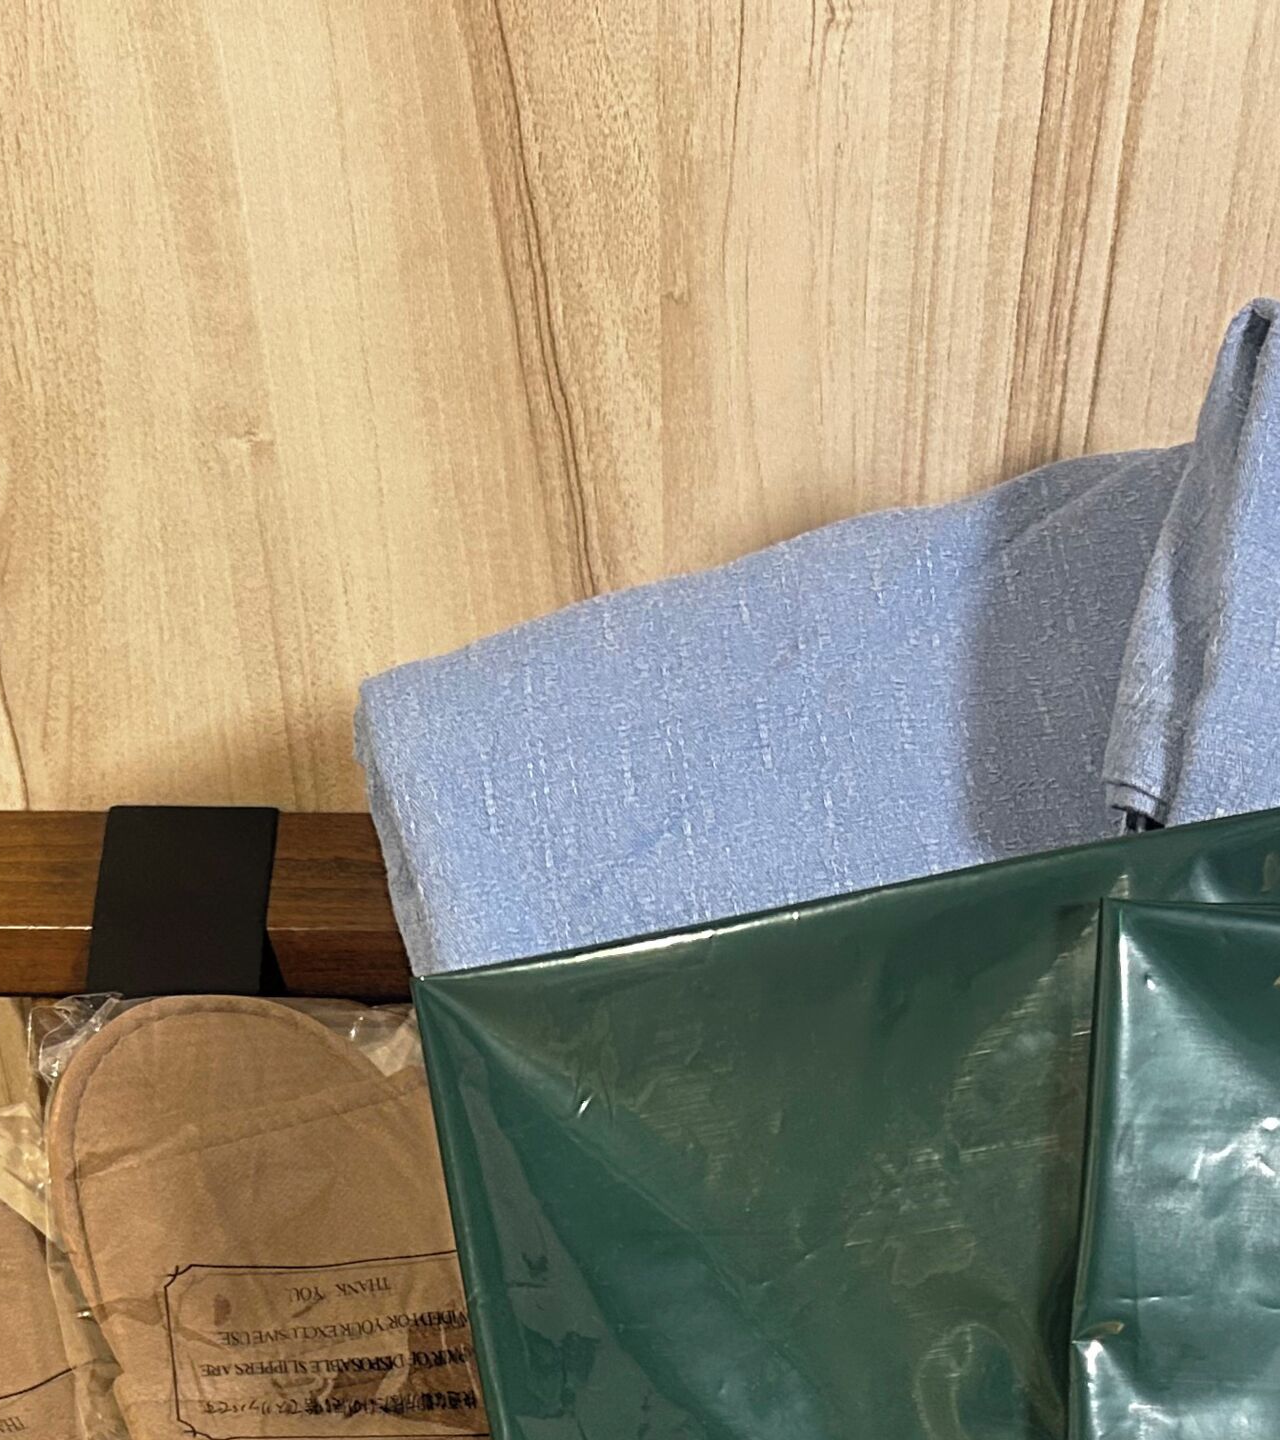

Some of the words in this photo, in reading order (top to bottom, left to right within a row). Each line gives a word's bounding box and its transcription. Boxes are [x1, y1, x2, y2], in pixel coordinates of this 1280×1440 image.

[335, 1276, 391, 1296] THANK
[292, 1287, 324, 1302] YOU
[253, 1325, 336, 1344] EXCLUSIVE
[340, 1317, 384, 1337] YOUR
[218, 1331, 251, 1346] USE
[200, 1364, 232, 1377] ARE
[234, 1360, 308, 1376] SLIPPERS
